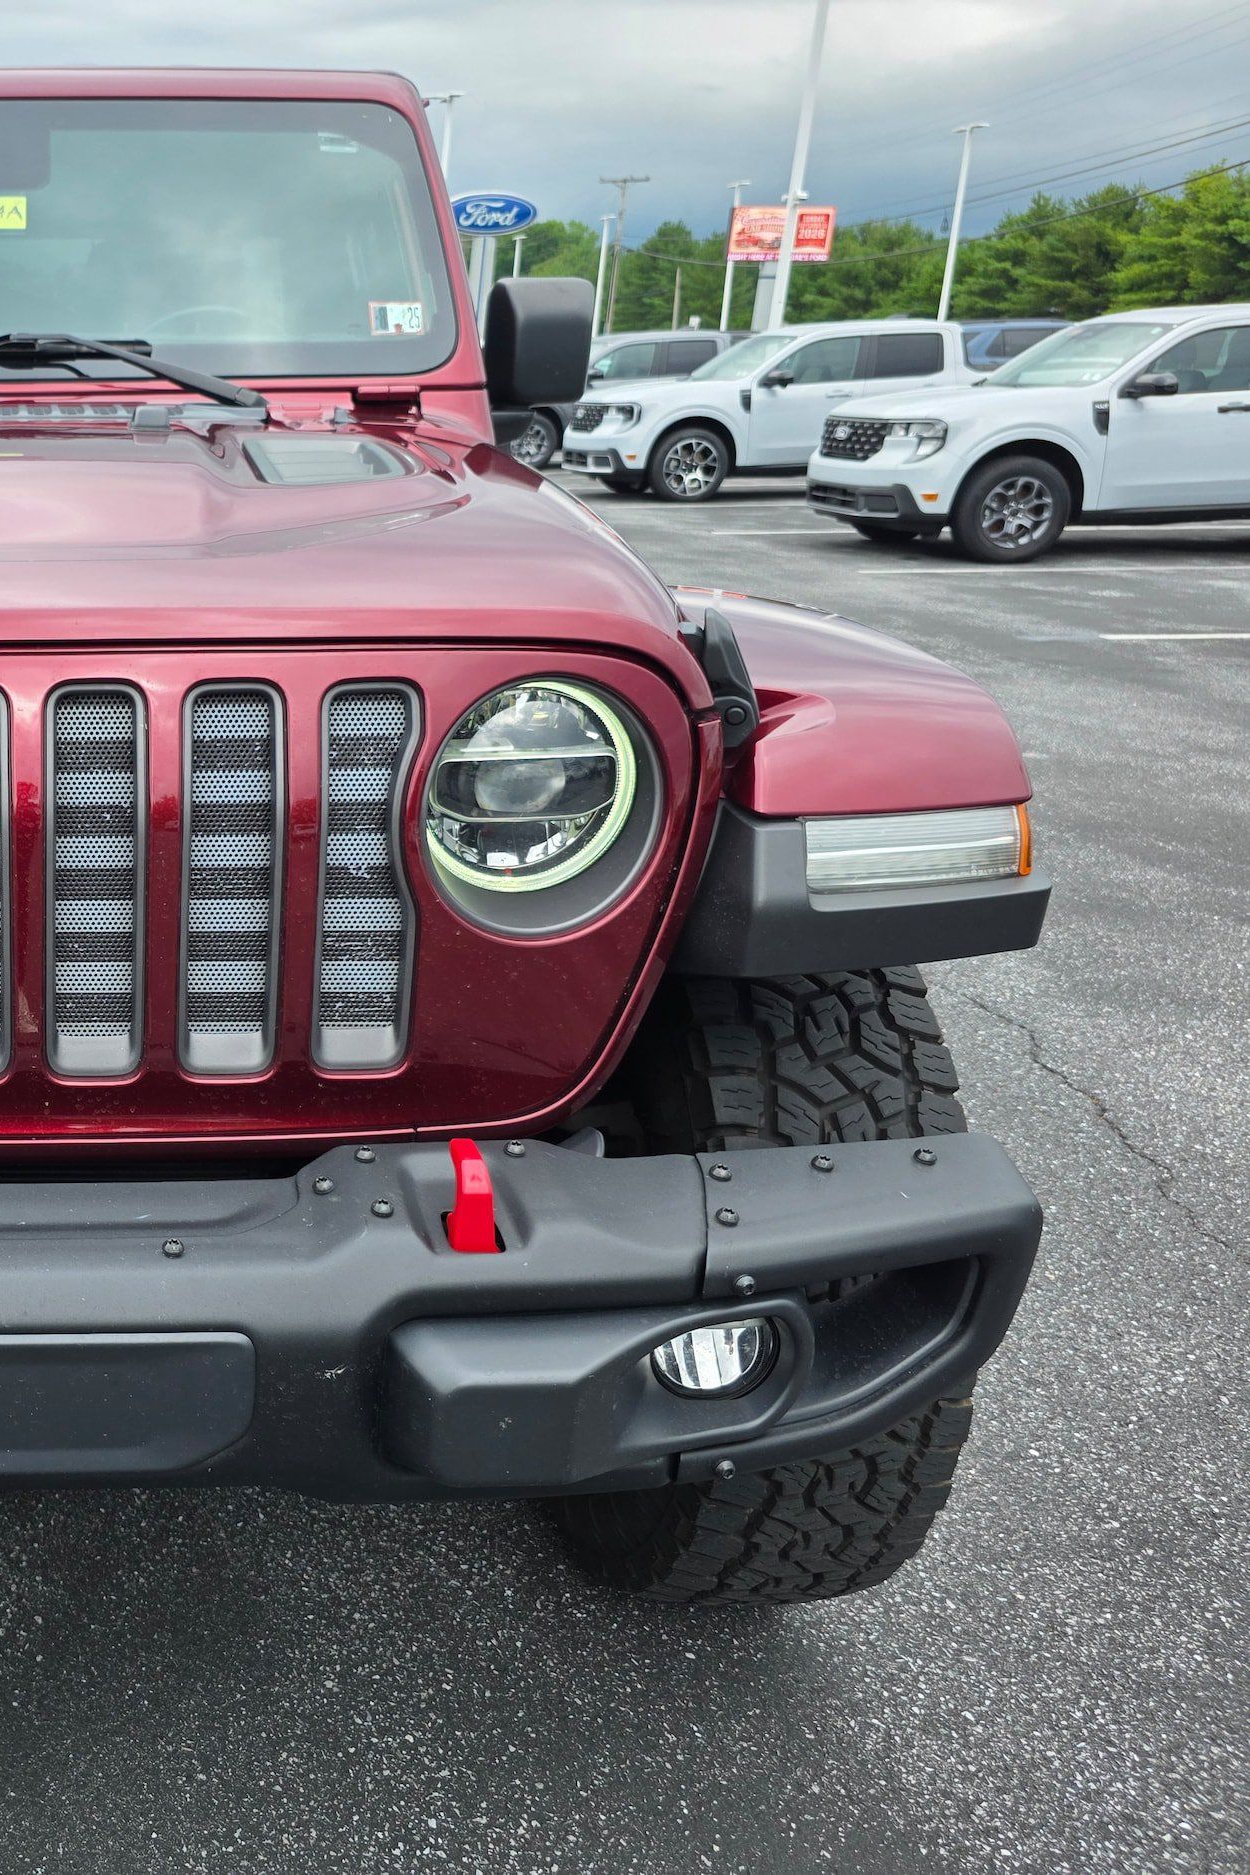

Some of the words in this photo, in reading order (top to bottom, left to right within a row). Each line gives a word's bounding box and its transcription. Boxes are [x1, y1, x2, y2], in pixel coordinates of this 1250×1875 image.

[459, 201, 519, 227] Ford
[797, 229, 826, 240] 2026
[407, 306, 420, 329] 25
